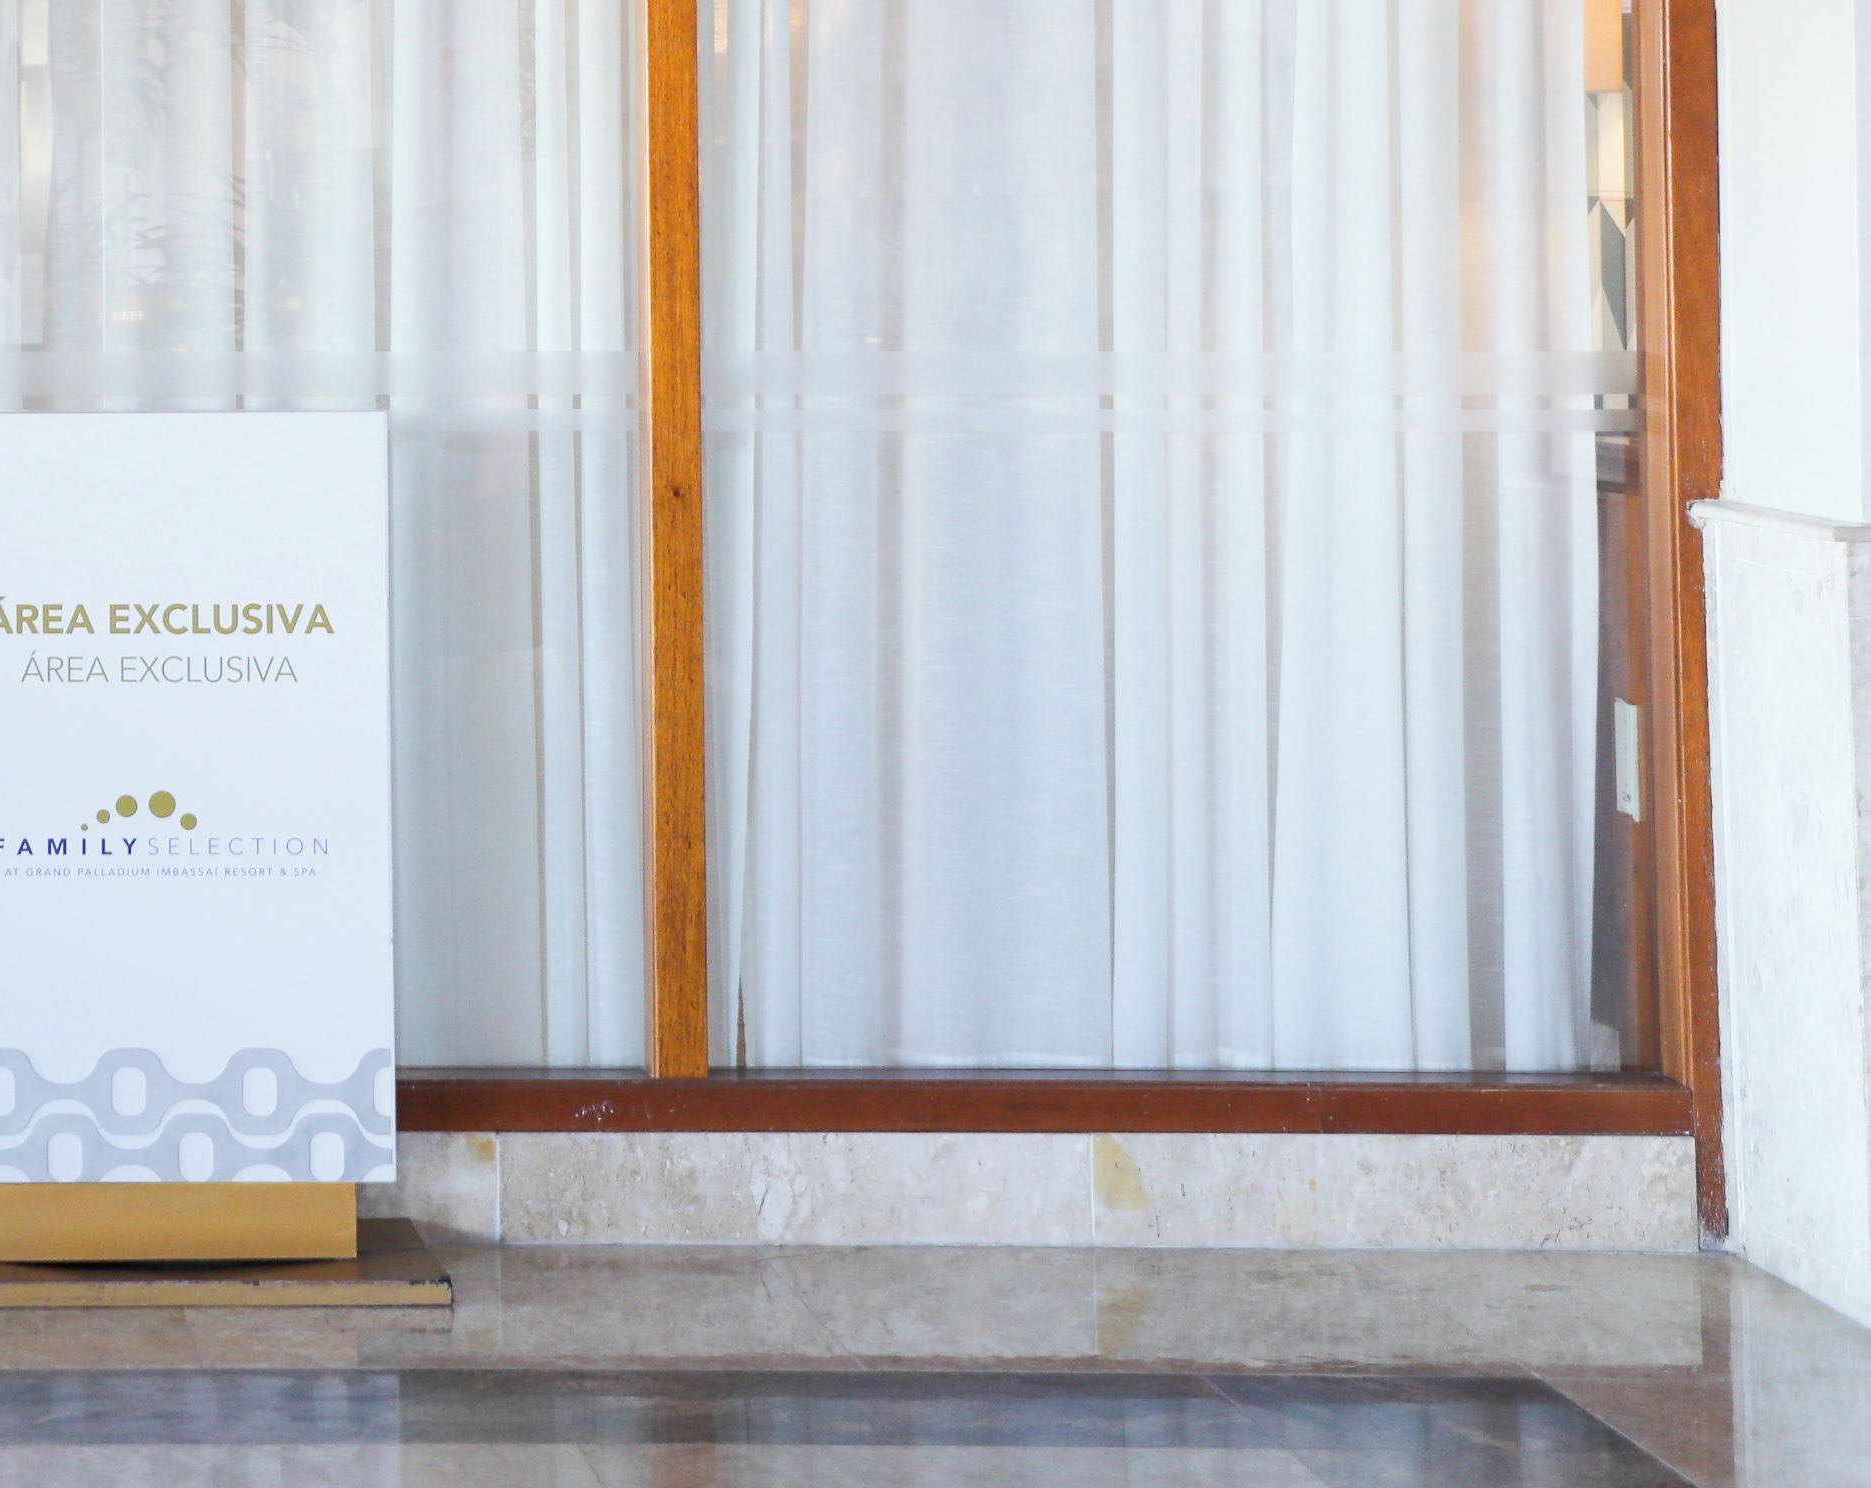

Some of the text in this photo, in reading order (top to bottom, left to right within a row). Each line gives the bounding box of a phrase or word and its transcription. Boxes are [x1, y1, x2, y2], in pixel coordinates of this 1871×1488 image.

[109, 602, 335, 636] EXCLUSIVA
[20, 649, 299, 684] ÁREA EXCLUSIVA
[4, 866, 20, 878] AT
[25, 866, 72, 878] GRAND
[77, 866, 151, 878] PALLADIUM
[224, 866, 273, 878] RESORT
[279, 866, 288, 878] &
[293, 866, 318, 878] SPA
